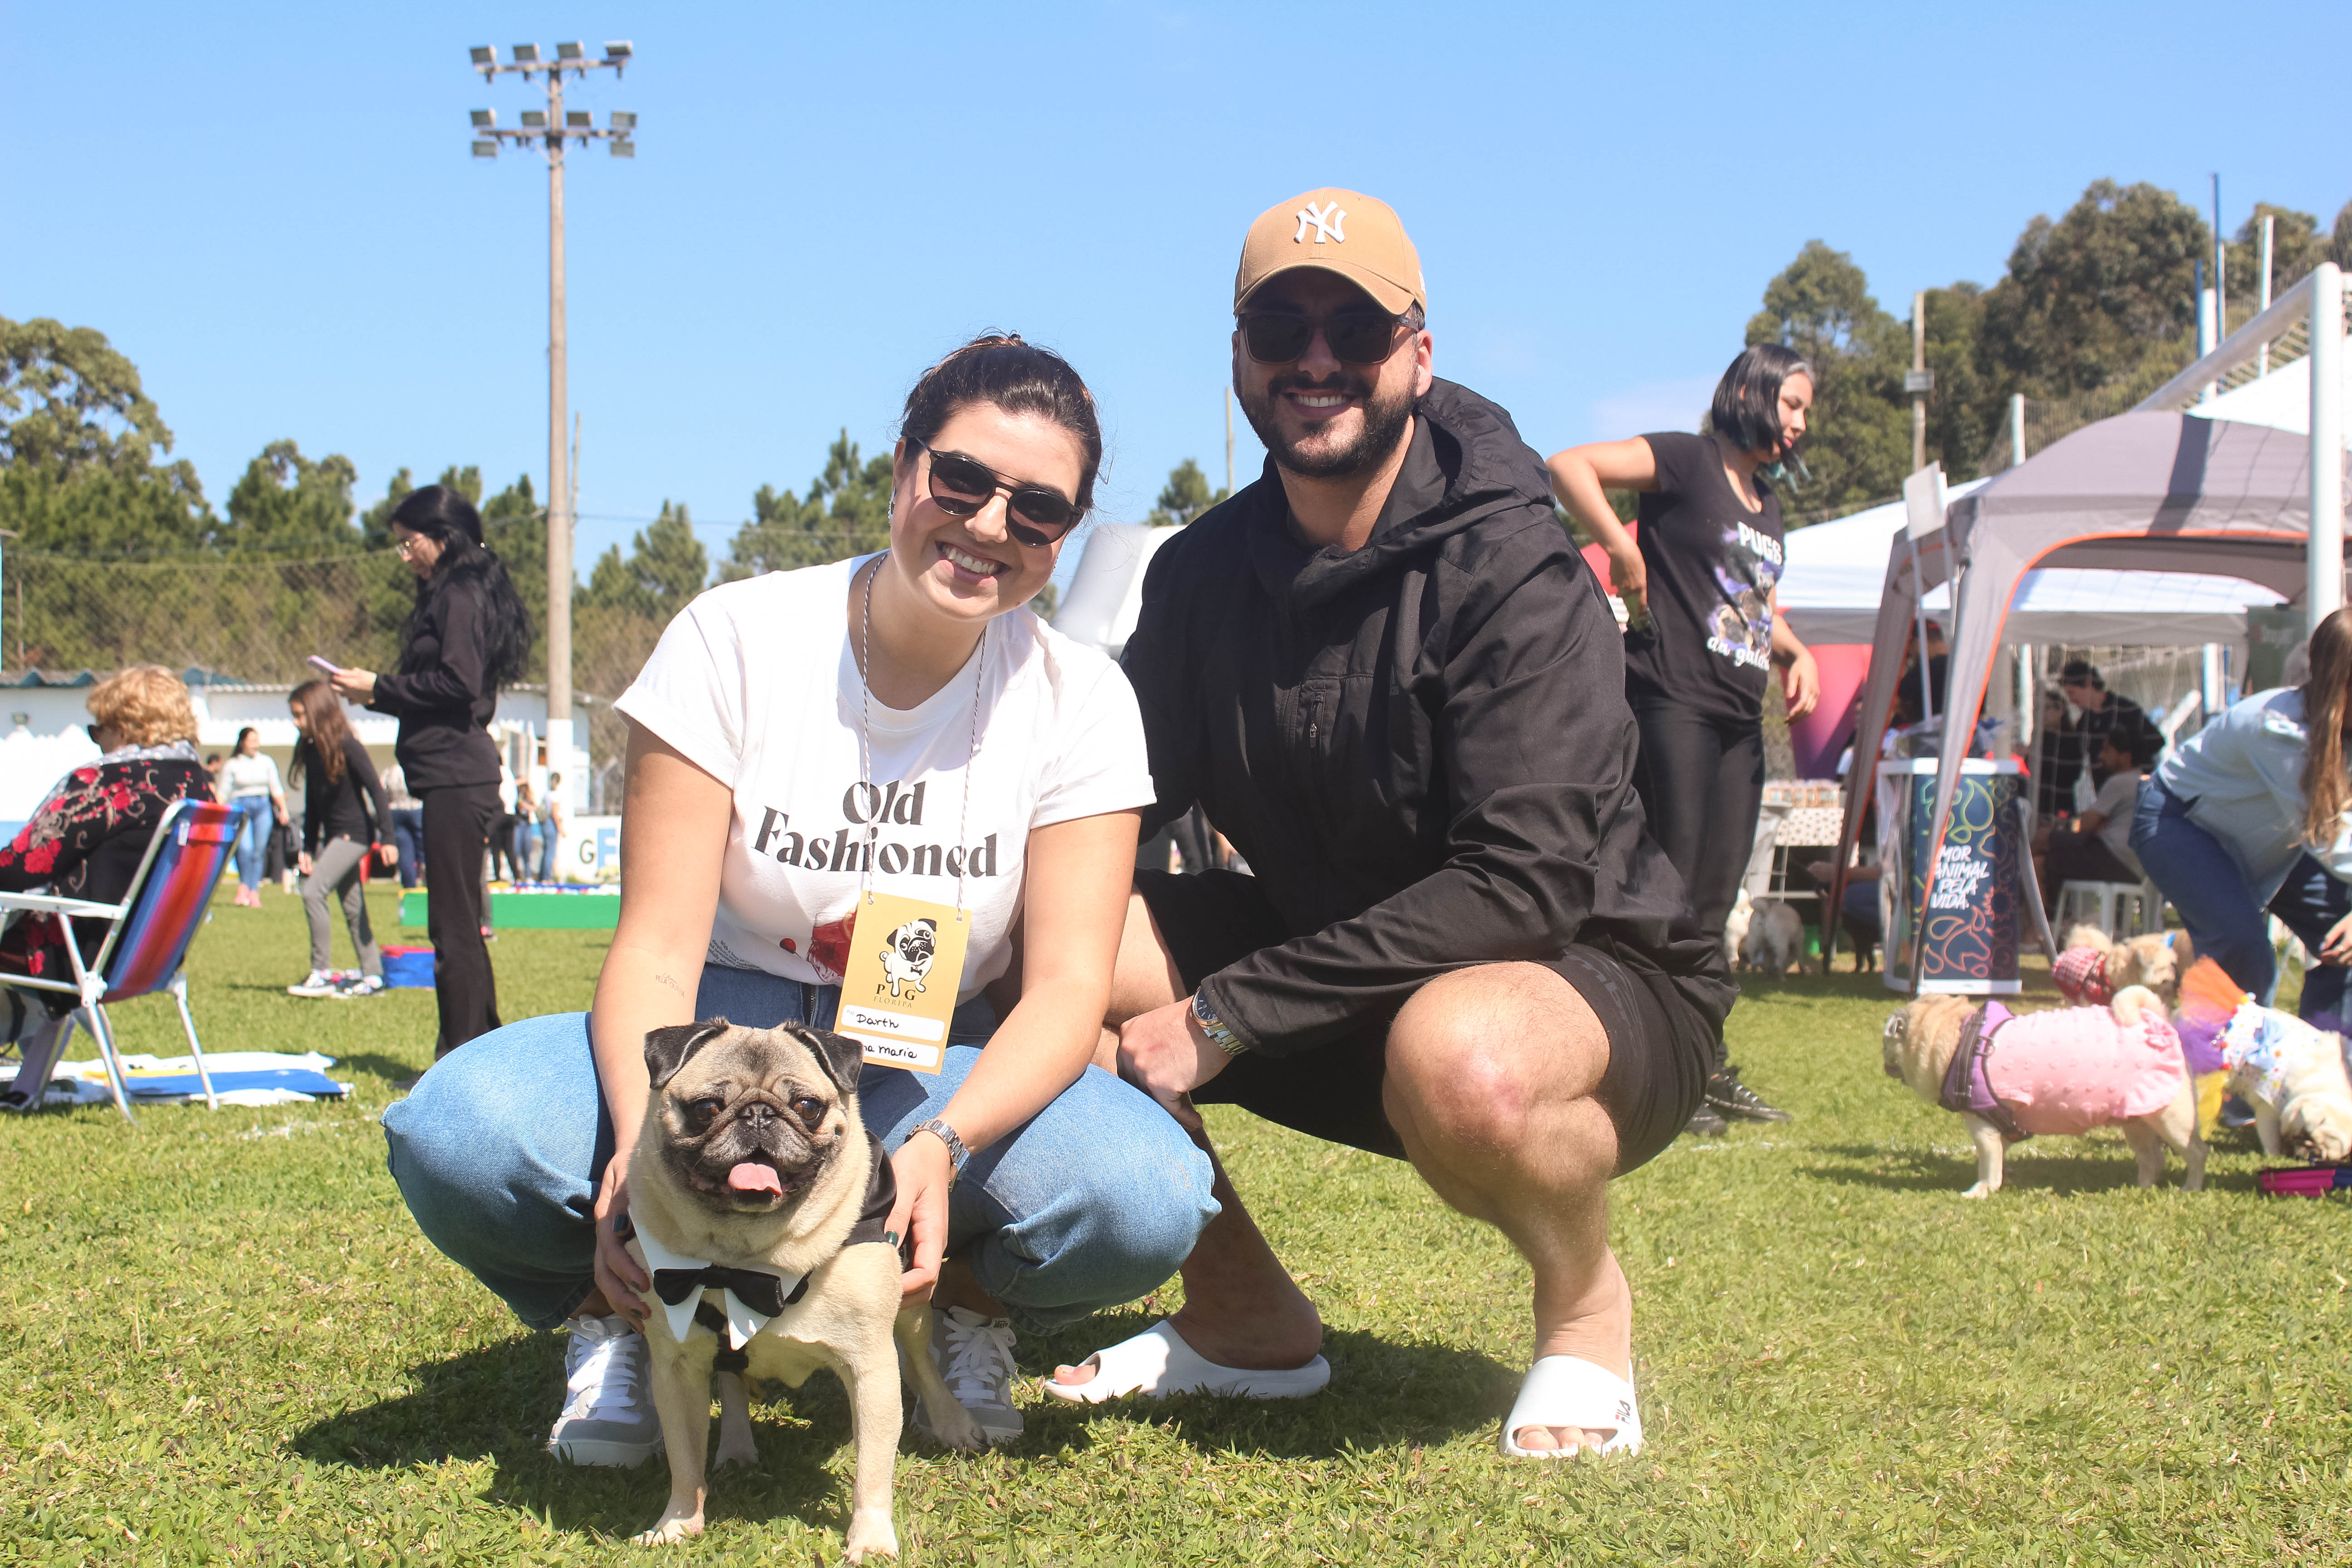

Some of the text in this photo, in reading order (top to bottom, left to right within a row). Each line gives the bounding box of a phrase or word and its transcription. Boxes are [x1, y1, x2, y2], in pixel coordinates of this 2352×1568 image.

[1737, 521, 1783, 566] PUGS
[843, 780, 926, 826] Old
[751, 805, 999, 878] Fashioned
[1939, 844, 1972, 862] MOR
[1935, 861, 1990, 880] ANIMAL
[1939, 877, 1979, 896] PELA
[1930, 892, 1970, 910] VIDA.
[873, 996, 912, 1008] FLORIPA
[856, 1014, 899, 1028] Darth
